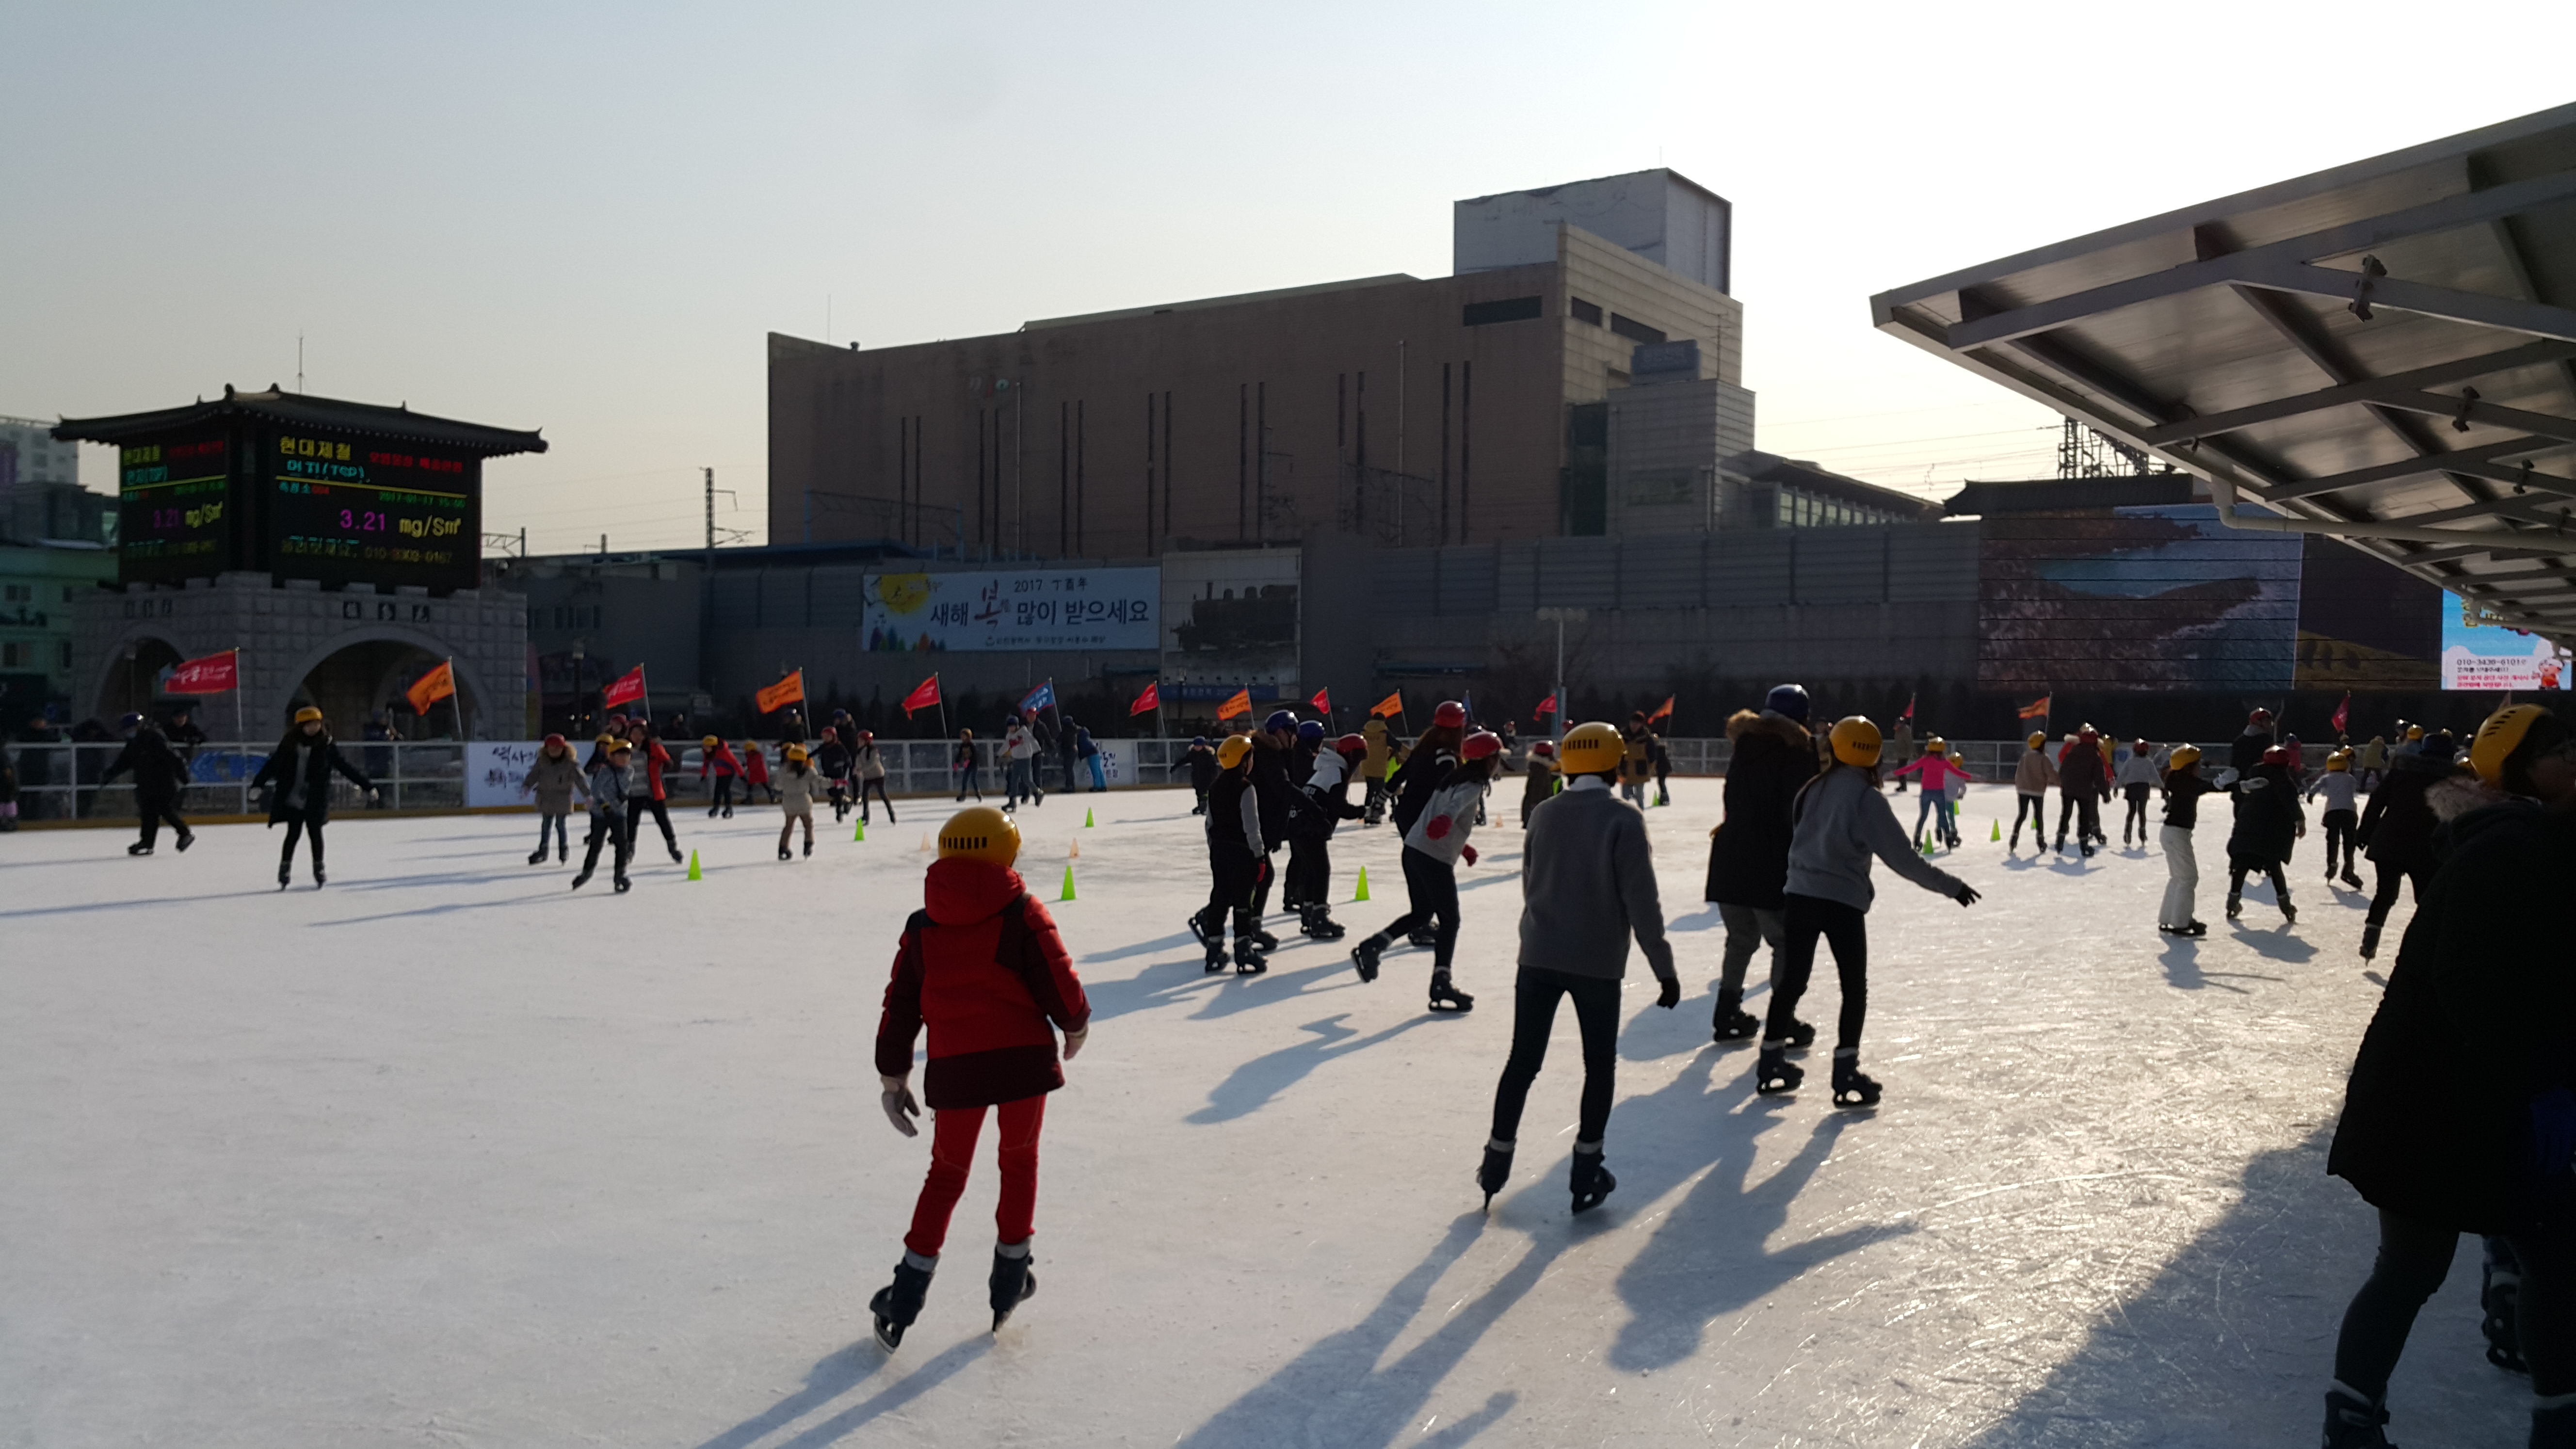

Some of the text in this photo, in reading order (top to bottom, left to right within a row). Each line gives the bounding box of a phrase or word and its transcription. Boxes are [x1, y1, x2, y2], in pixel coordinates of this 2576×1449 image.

[340, 509, 386, 531] 3.21
[1014, 579, 1043, 593] 2017
[930, 601, 968, 627] 새해
[974, 579, 999, 629] 복
[1017, 600, 1056, 626] 많이
[1065, 599, 1149, 626] 받으세요
